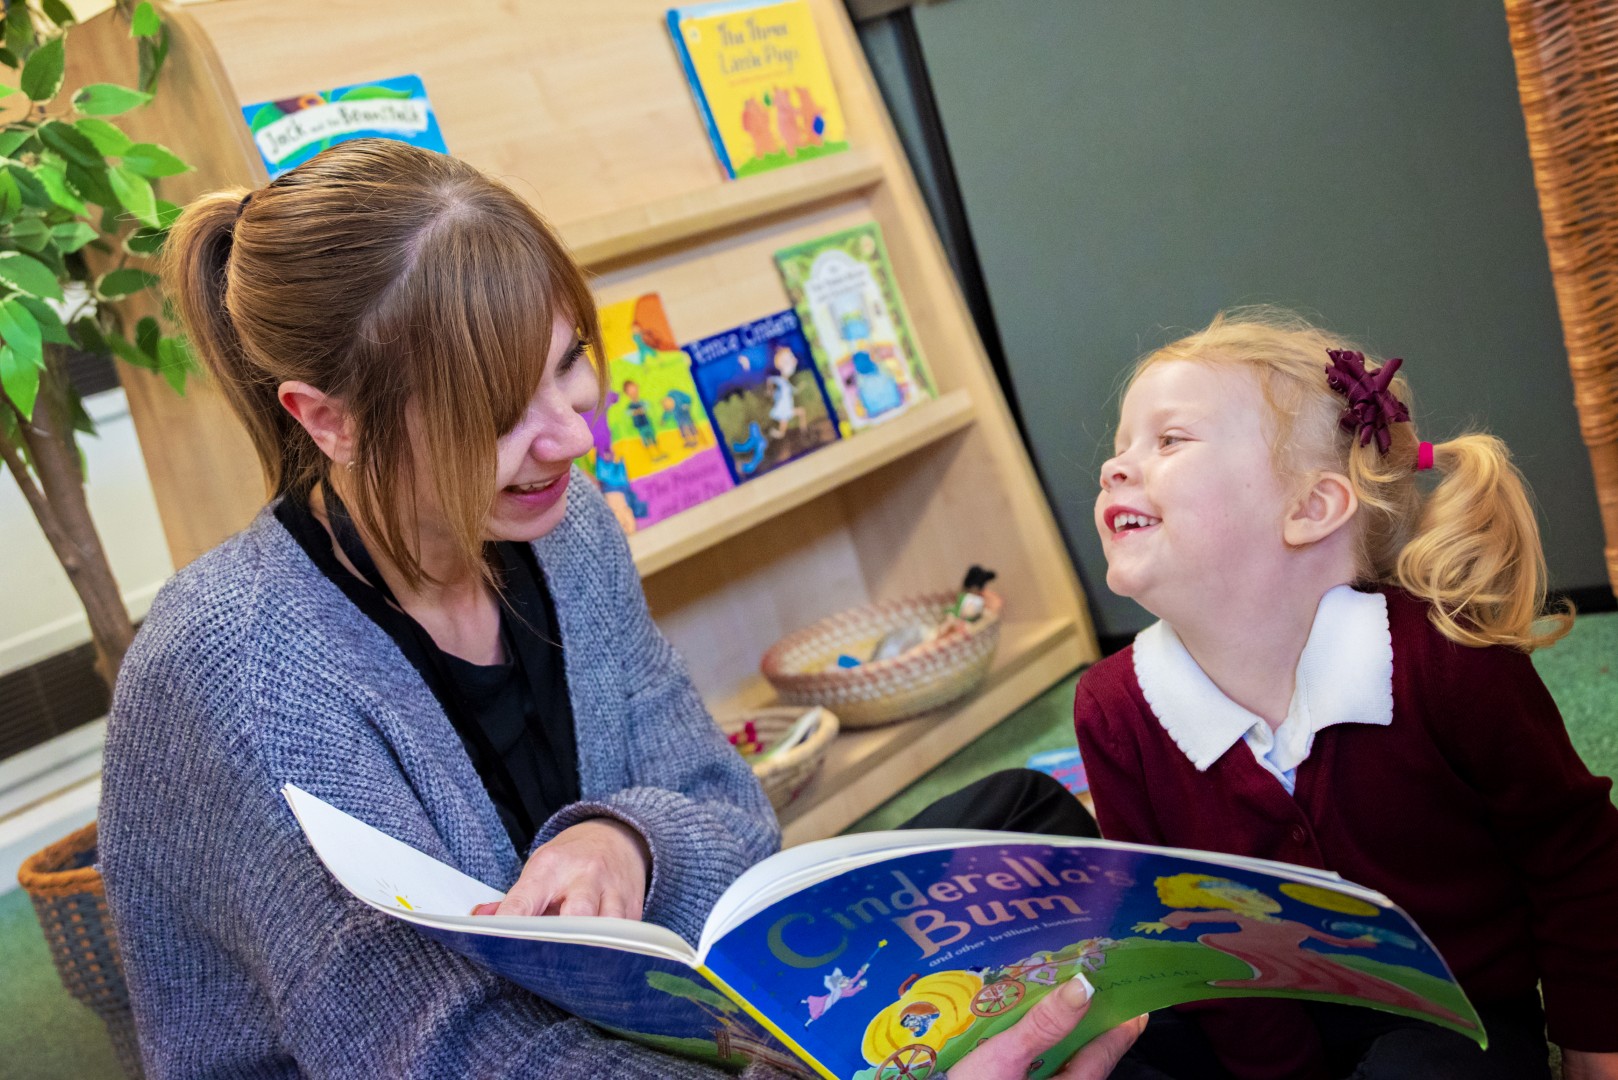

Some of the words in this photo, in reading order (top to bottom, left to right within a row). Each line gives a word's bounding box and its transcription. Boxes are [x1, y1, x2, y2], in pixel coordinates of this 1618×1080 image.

[266, 118, 304, 154] Jack
[767, 856, 1136, 969] Cinderella's
[892, 895, 1090, 960] Bum
[929, 951, 954, 967] and
[955, 939, 987, 957] other
[988, 923, 1040, 943] brilliant
[1042, 917, 1093, 929] bottoms
